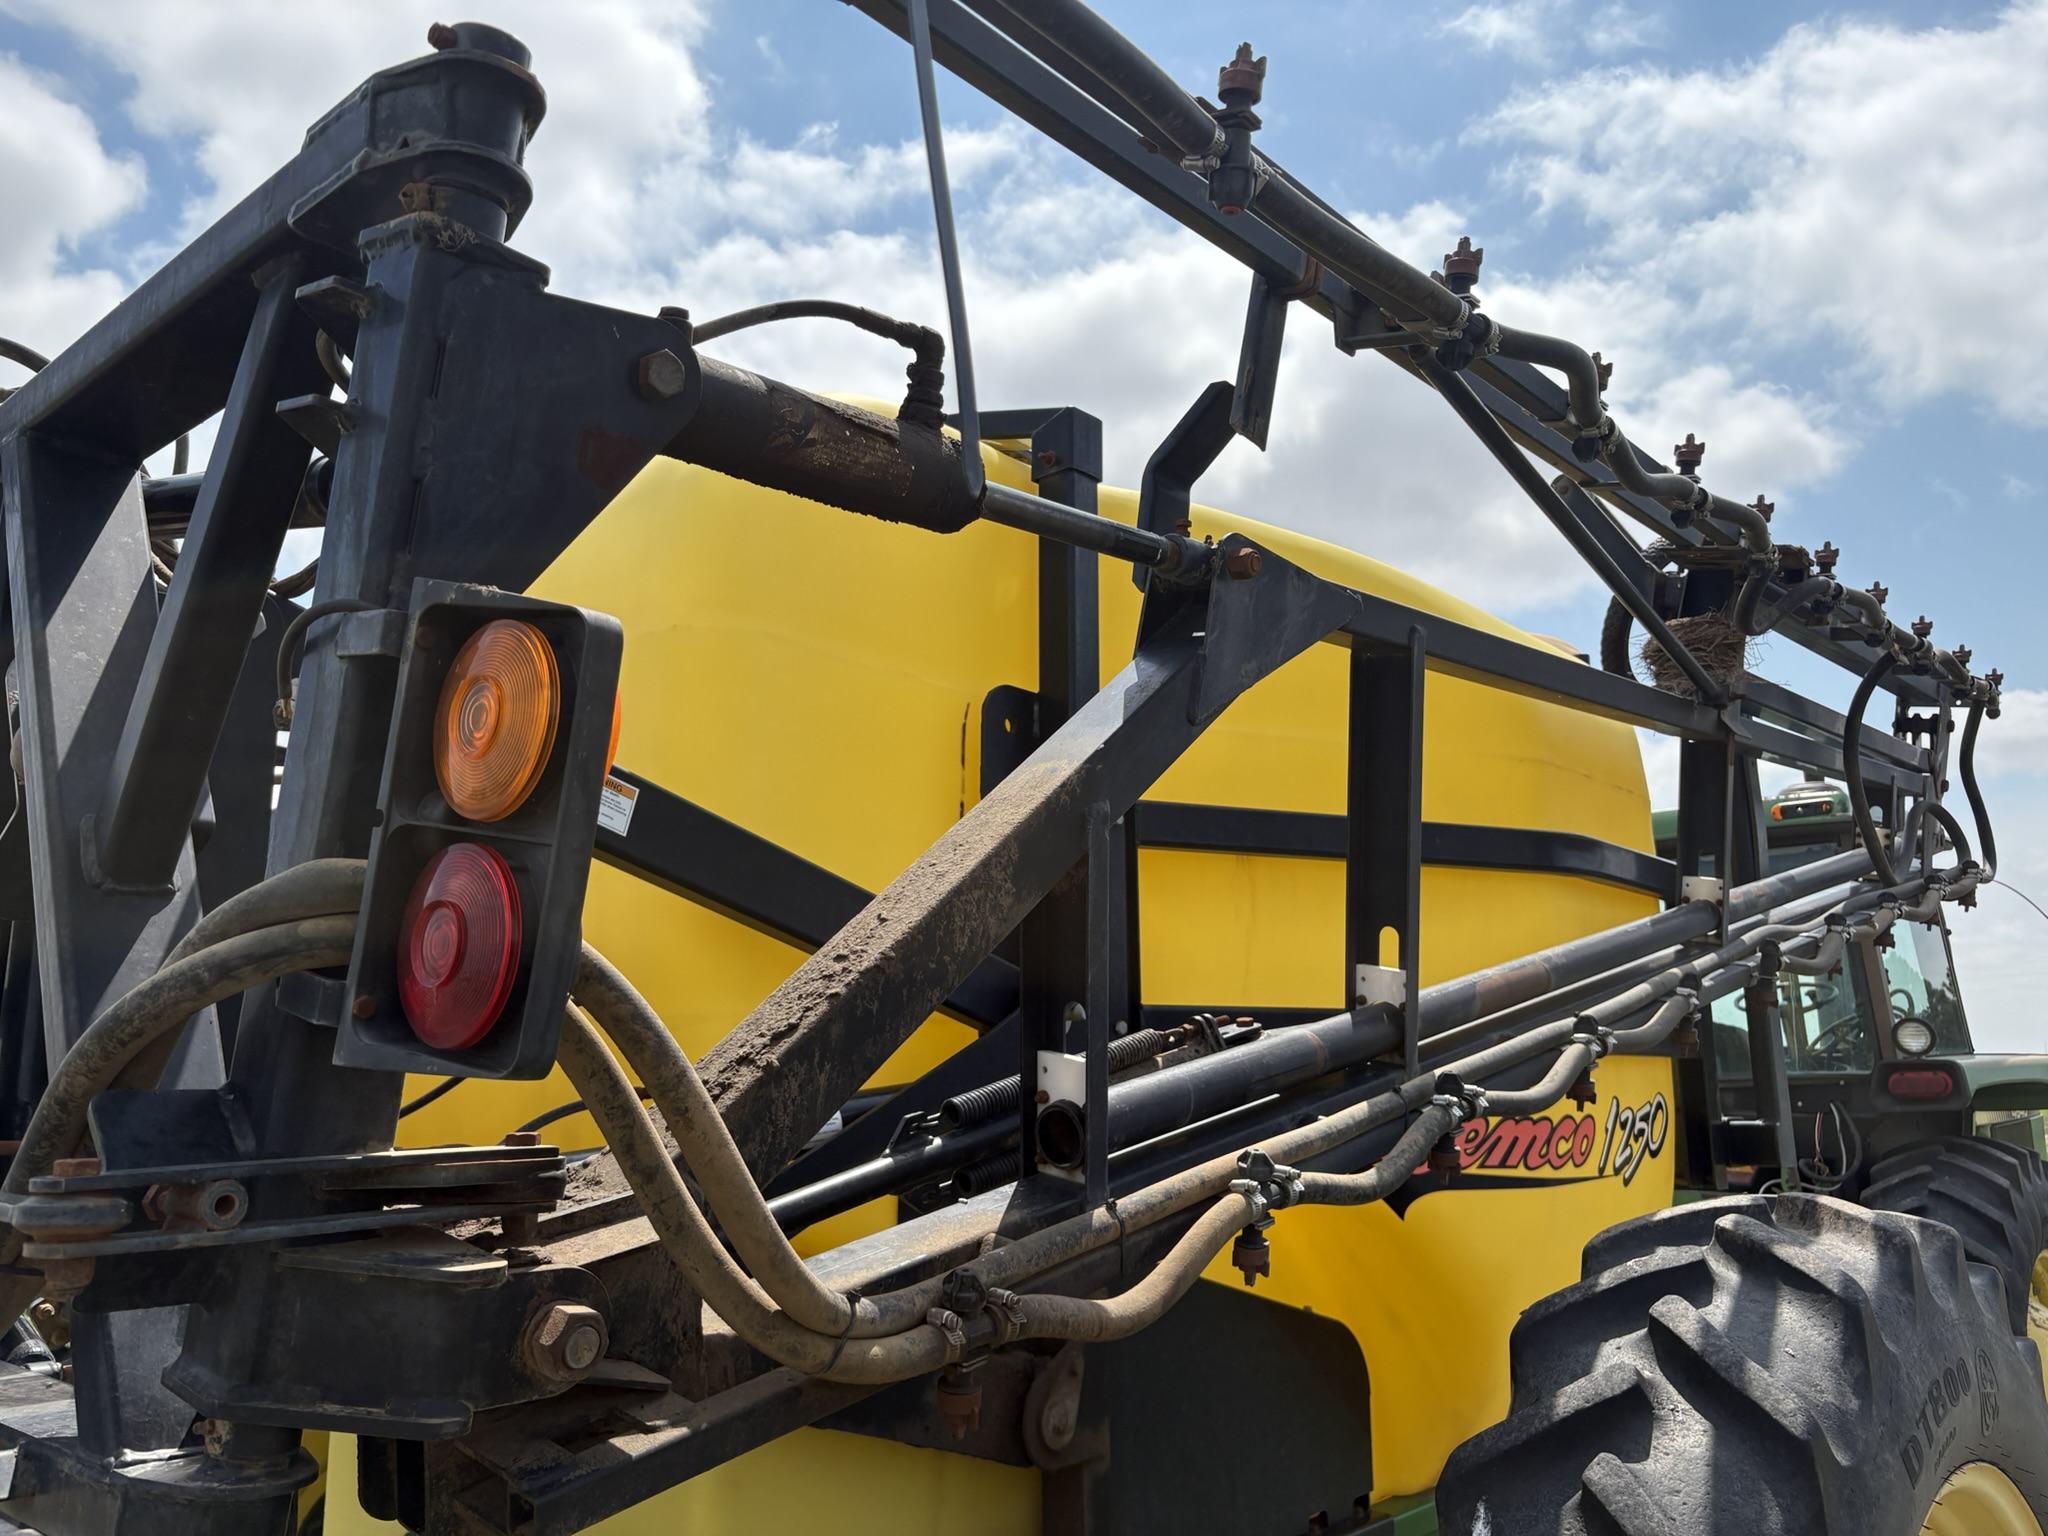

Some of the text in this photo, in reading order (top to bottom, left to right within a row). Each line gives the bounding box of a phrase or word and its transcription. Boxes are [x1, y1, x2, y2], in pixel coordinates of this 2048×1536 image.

[605, 779, 623, 793] NING
[1411, 1091, 1669, 1187] emco 1250
[1901, 1357, 1972, 1490] DT800
